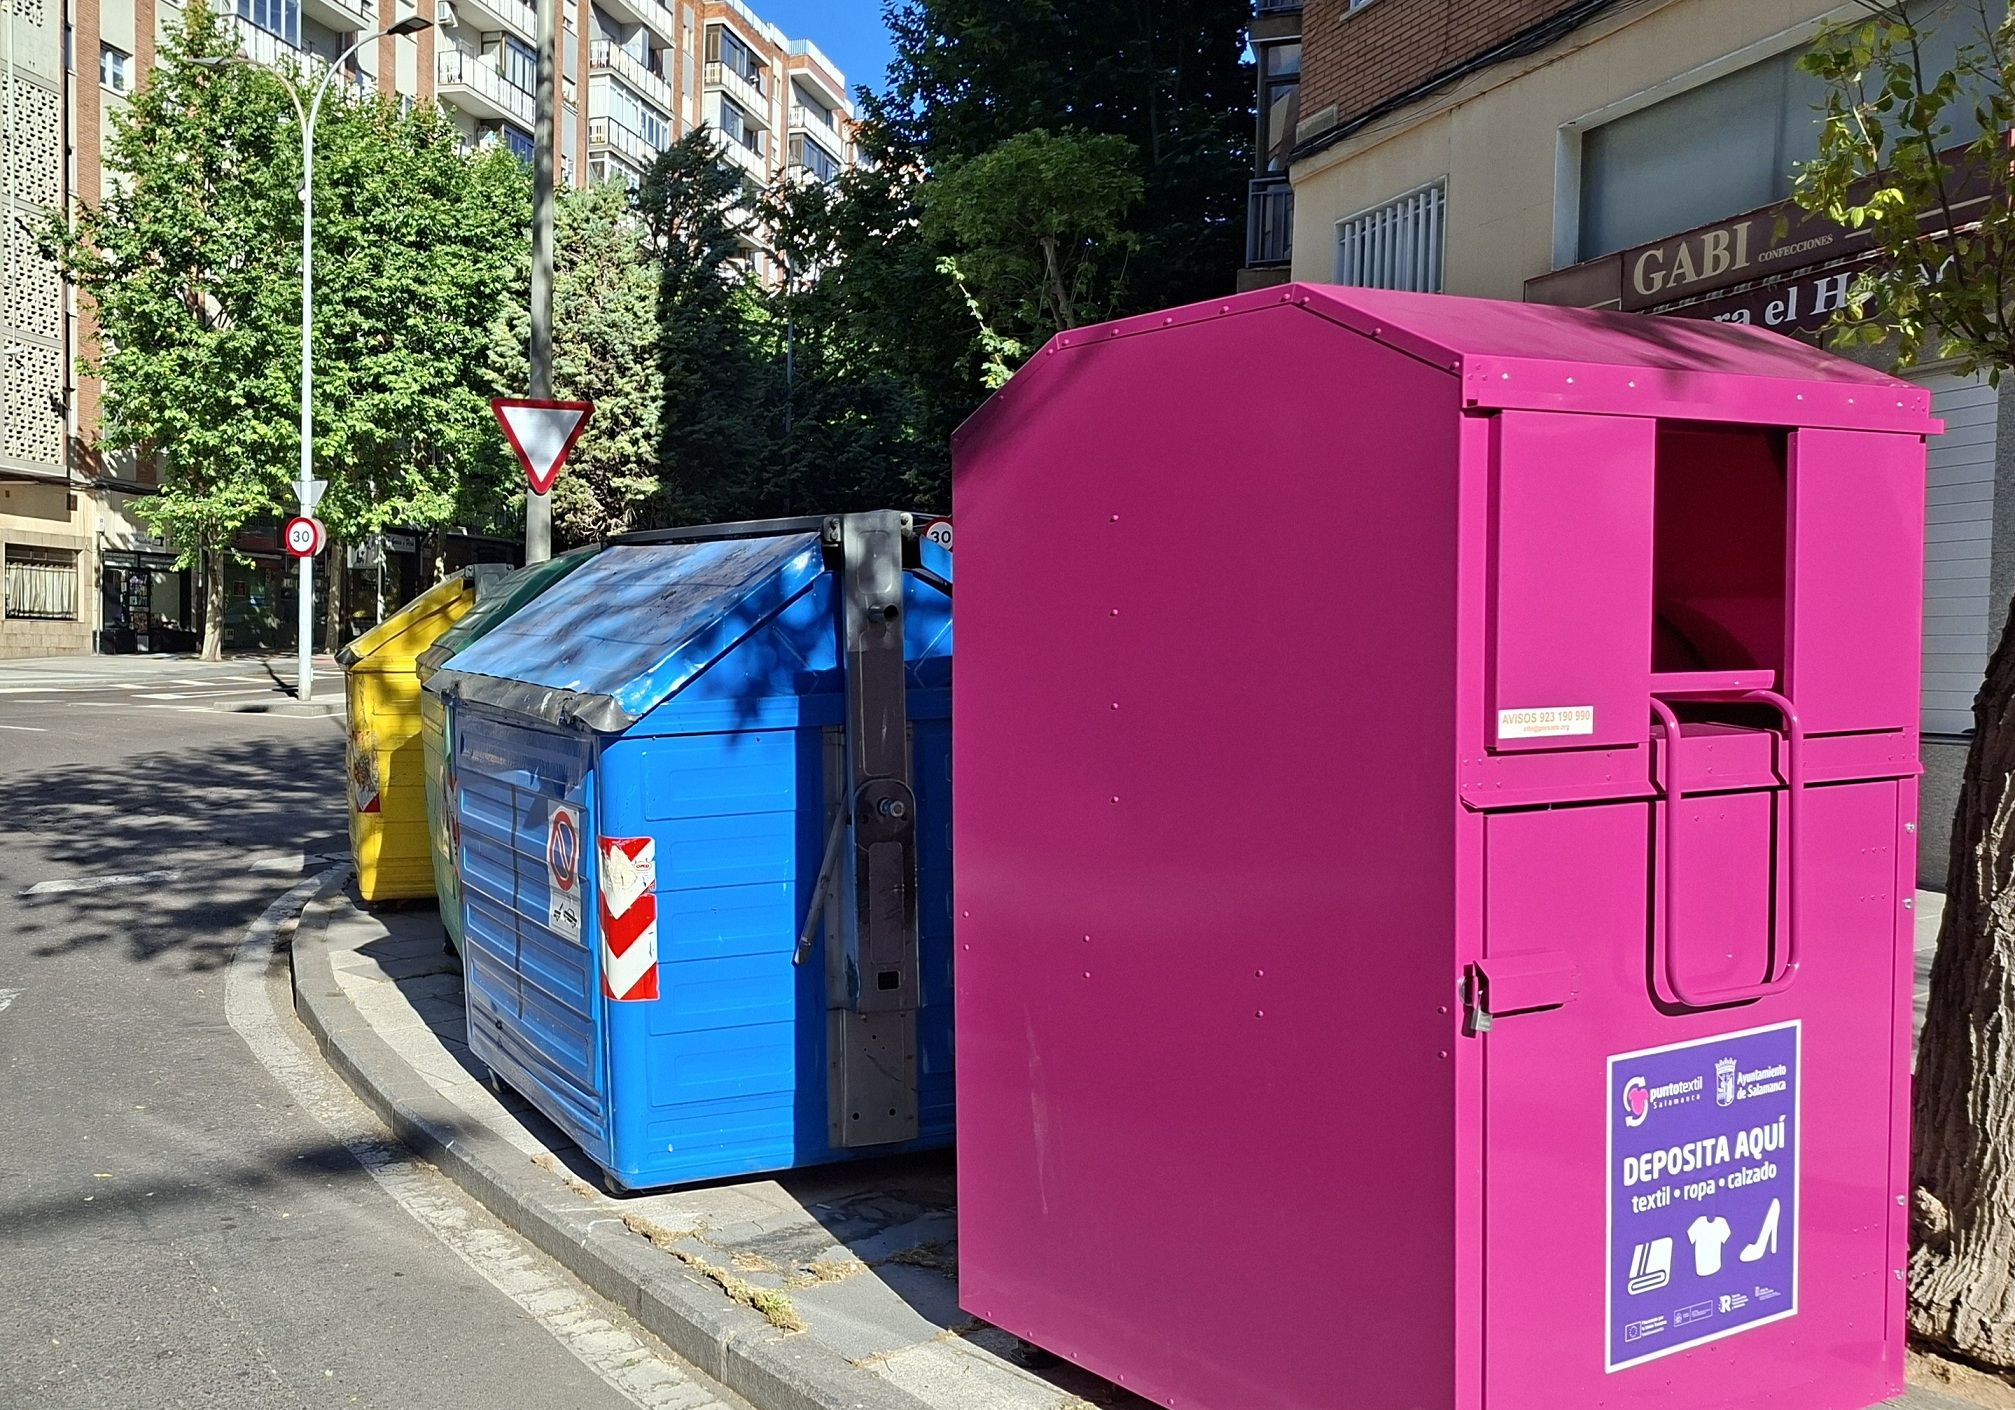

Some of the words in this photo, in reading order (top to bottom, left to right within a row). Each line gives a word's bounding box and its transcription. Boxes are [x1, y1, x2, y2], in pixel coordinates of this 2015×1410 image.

[1633, 221, 1752, 295] GABI
[1758, 234, 1834, 263] CONFECCIONES
[1764, 286, 1798, 326] el
[293, 530, 310, 542] 30
[930, 530, 952, 544] 30
[1502, 713, 1537, 724] AVISOS
[1540, 712, 1555, 722] 923
[1558, 711, 1573, 721] 190
[1575, 710, 1590, 720] 990
[1736, 1064, 1787, 1087] Ayuntamiento
[1650, 1076, 1703, 1102] puntotextil
[1736, 1086, 1747, 1100] de
[1747, 1080, 1787, 1098] Salamanca
[1652, 1093, 1701, 1110] Salamanca
[1623, 1135, 1730, 1187] DEPOSITA
[1734, 1114, 1787, 1160] AQUÍ
[1631, 1185, 1671, 1214] textil
[1683, 1179, 1716, 1202] ropa
[1727, 1161, 1777, 1189] calzado
